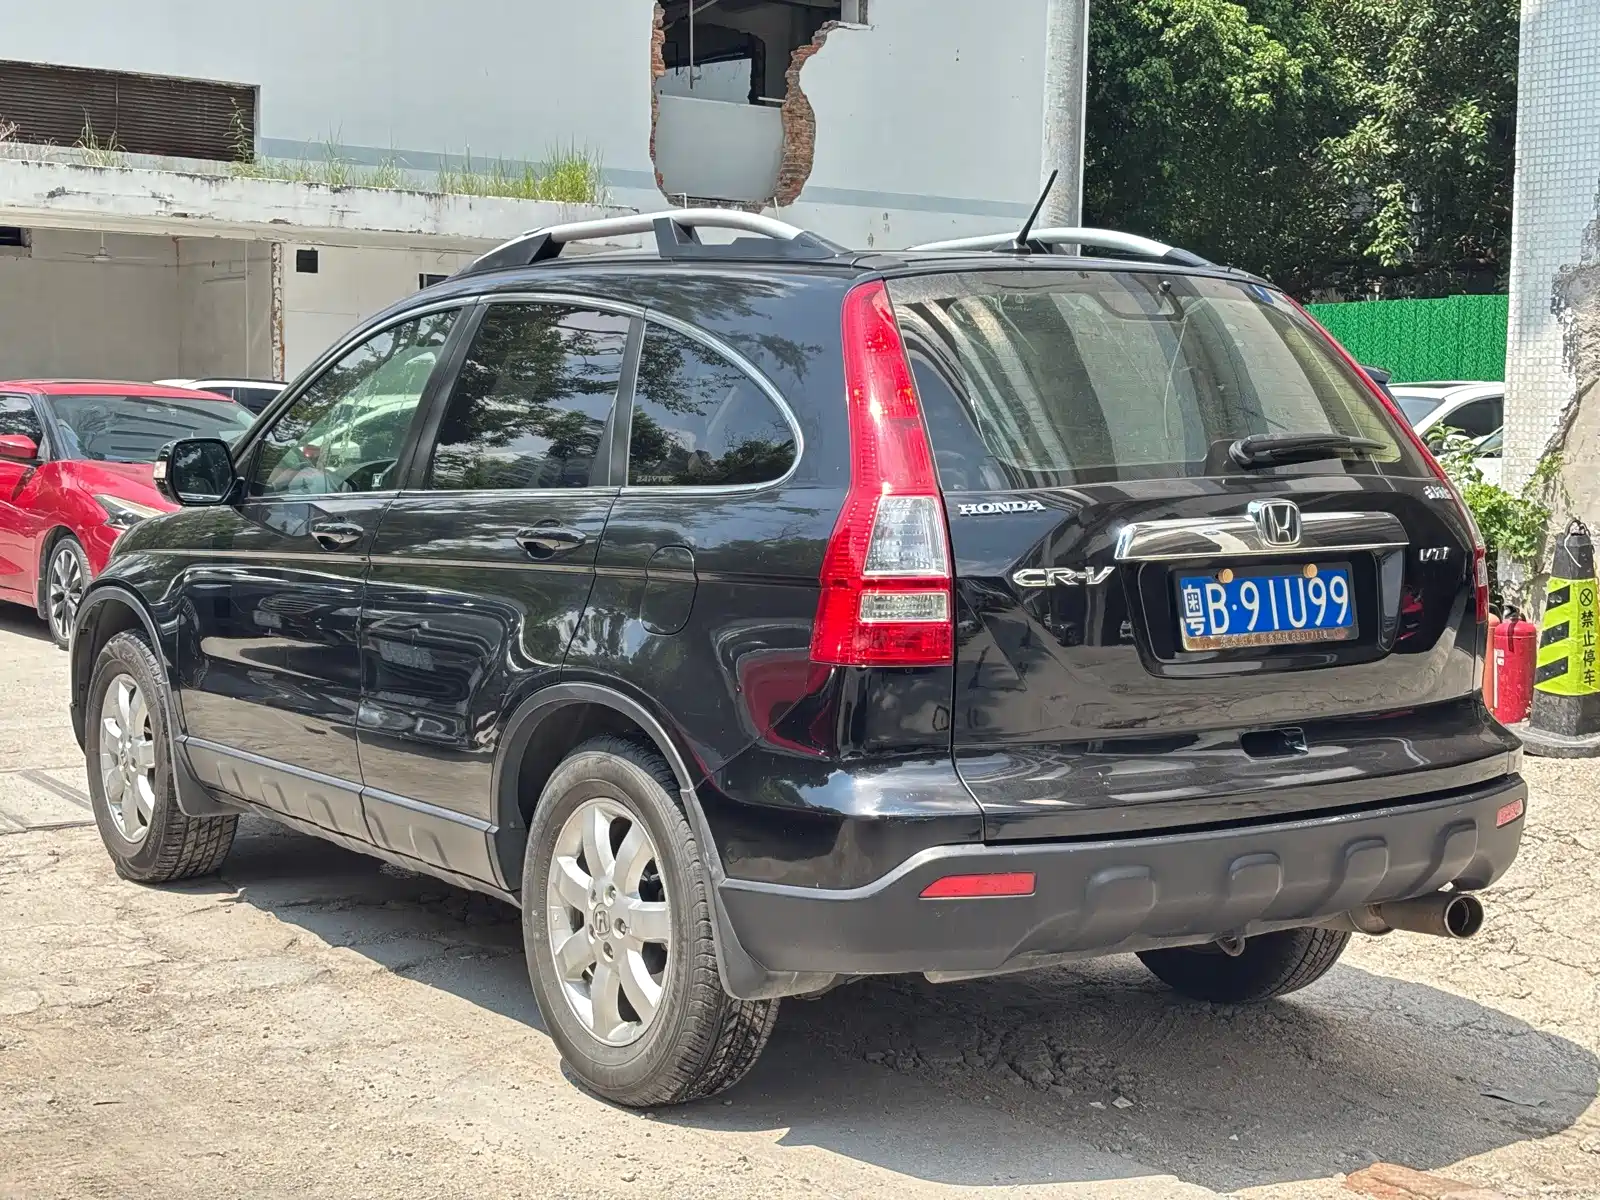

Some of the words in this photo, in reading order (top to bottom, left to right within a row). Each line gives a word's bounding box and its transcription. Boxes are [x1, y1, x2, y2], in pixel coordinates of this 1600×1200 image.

[957, 500, 1047, 517] HONDA
[1012, 566, 1116, 587] CR-V
[1581, 610, 1596, 686] 禁止停车
